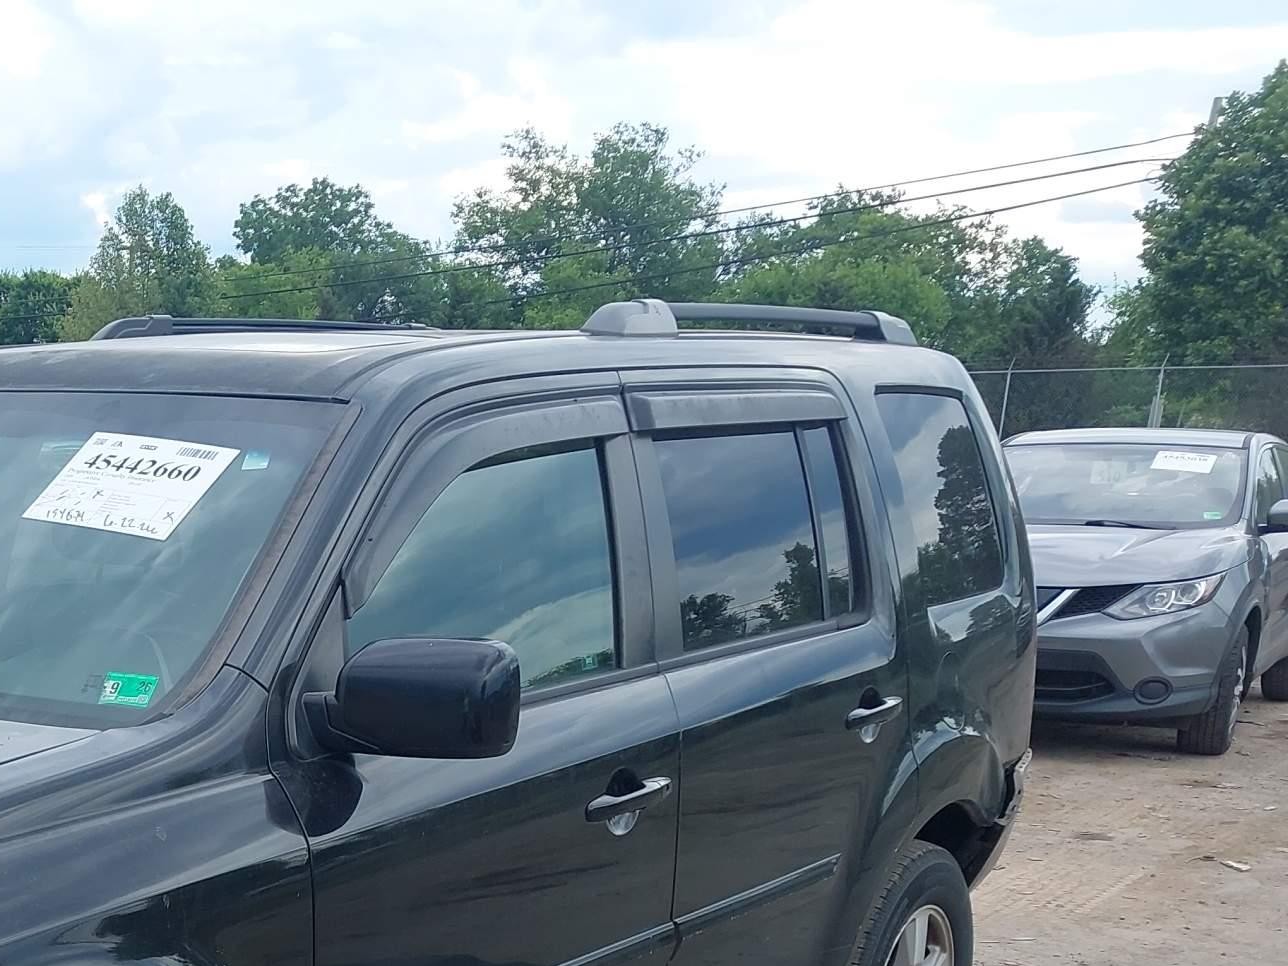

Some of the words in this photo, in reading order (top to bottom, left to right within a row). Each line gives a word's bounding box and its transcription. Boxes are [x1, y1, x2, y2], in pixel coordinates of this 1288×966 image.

[84, 452, 202, 482] 45442660
[109, 681, 121, 695] 9
[136, 680, 153, 693] 26
